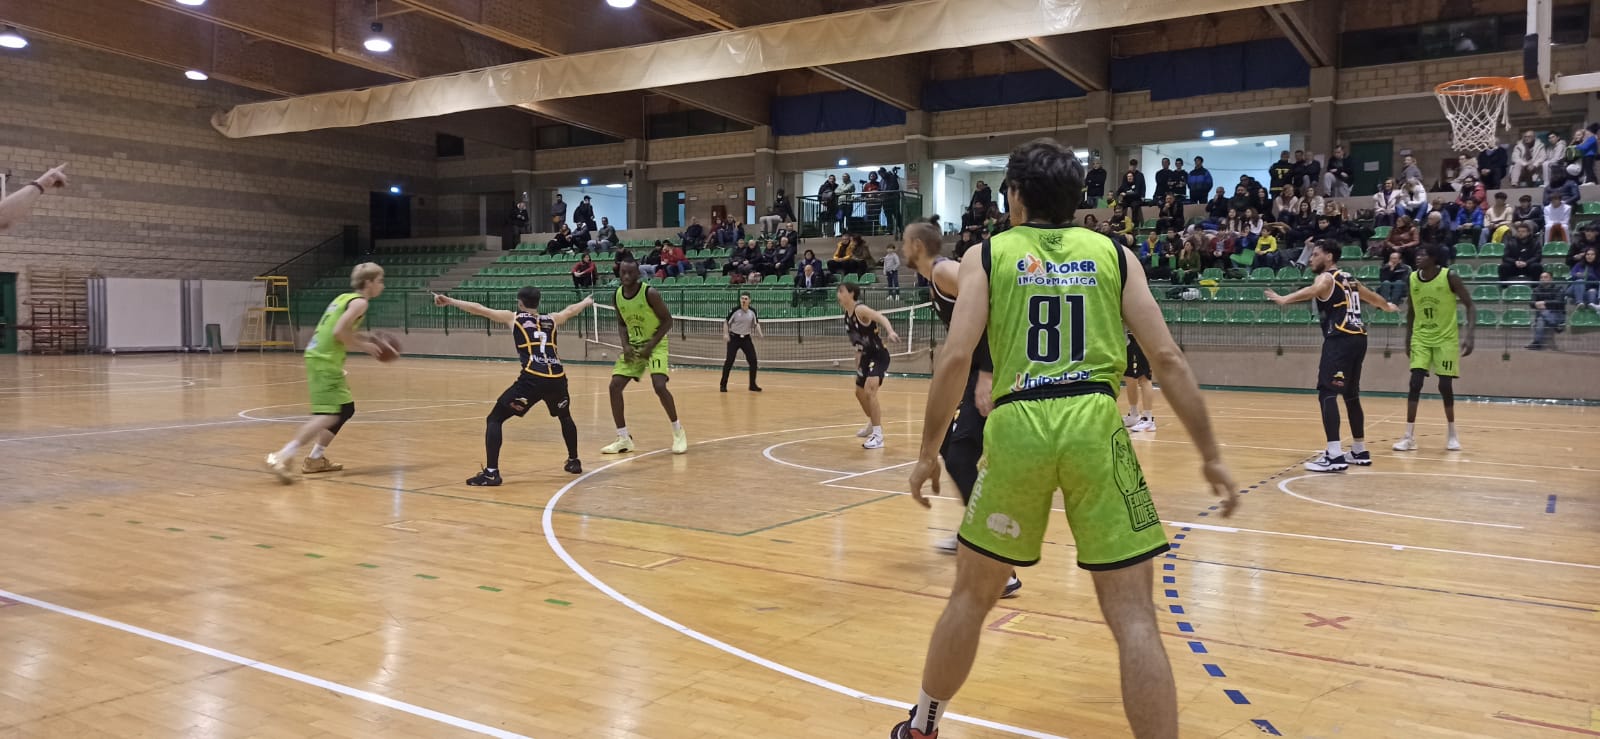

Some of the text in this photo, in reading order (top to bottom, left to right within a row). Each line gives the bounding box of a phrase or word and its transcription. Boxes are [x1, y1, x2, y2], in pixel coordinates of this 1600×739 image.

[1017, 254, 1096, 275] EXPLORER
[1018, 276, 1096, 285] INFORMATICA
[1027, 294, 1085, 364] 81
[533, 331, 547, 353] 7
[1442, 360, 1453, 371] 41
